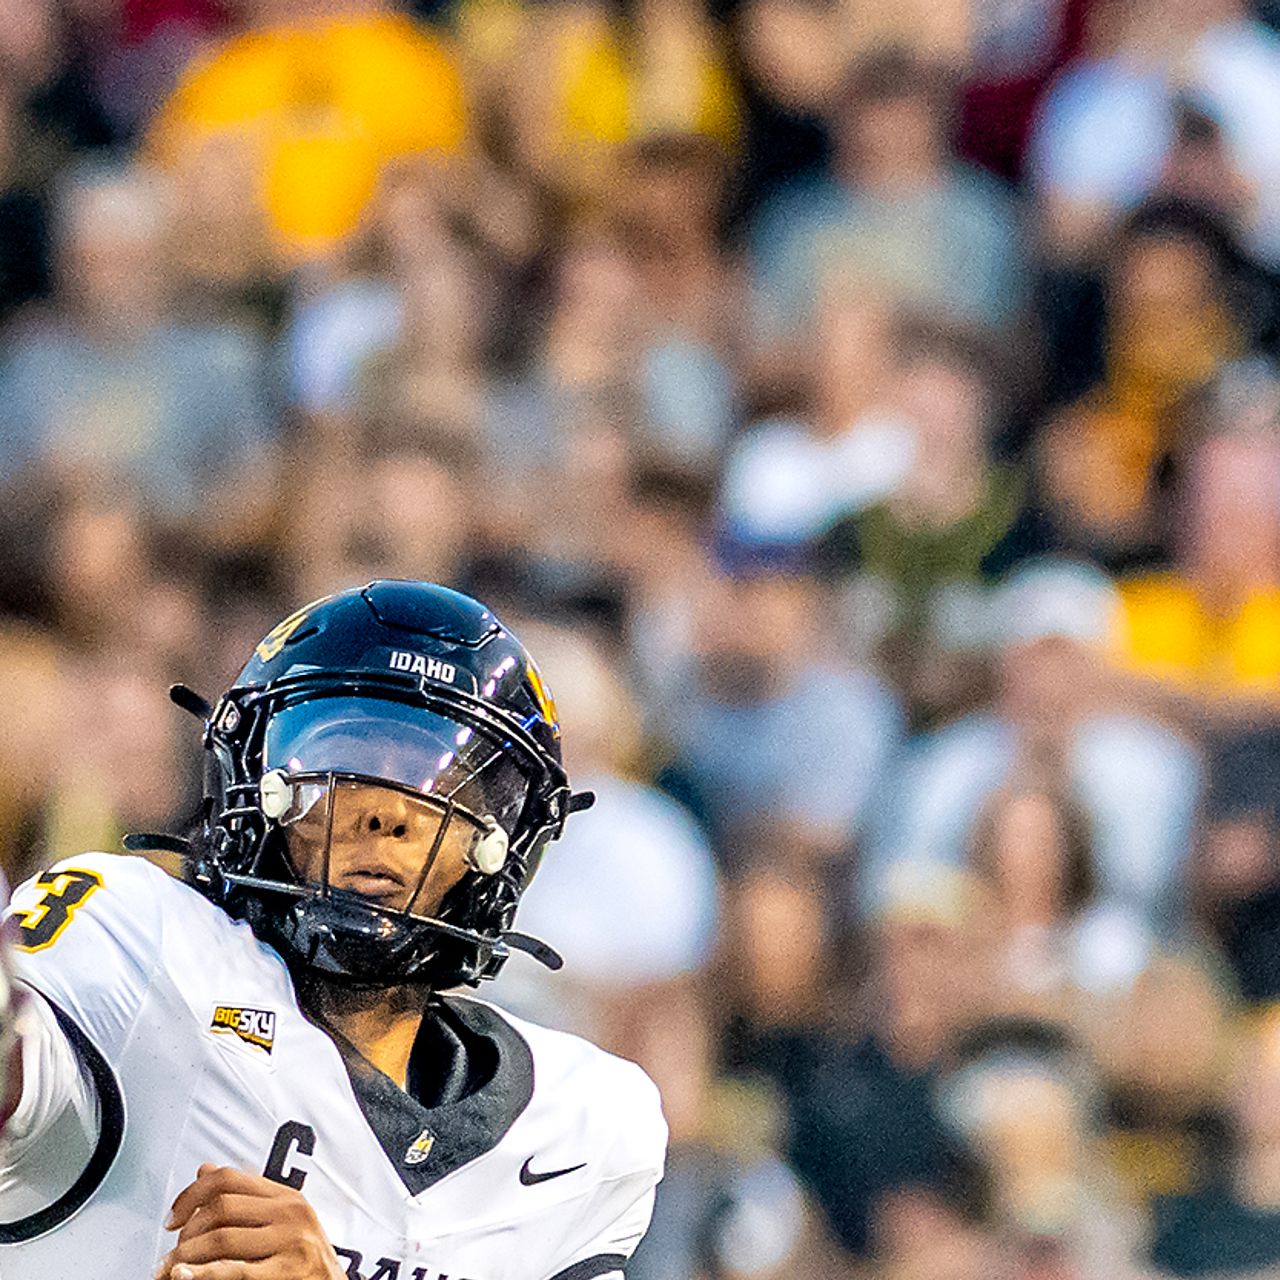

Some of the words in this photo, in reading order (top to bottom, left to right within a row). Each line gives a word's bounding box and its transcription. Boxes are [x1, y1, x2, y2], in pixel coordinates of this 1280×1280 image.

[389, 651, 456, 684] IDAHO
[14, 867, 104, 954] 3
[263, 1120, 317, 1191] C
